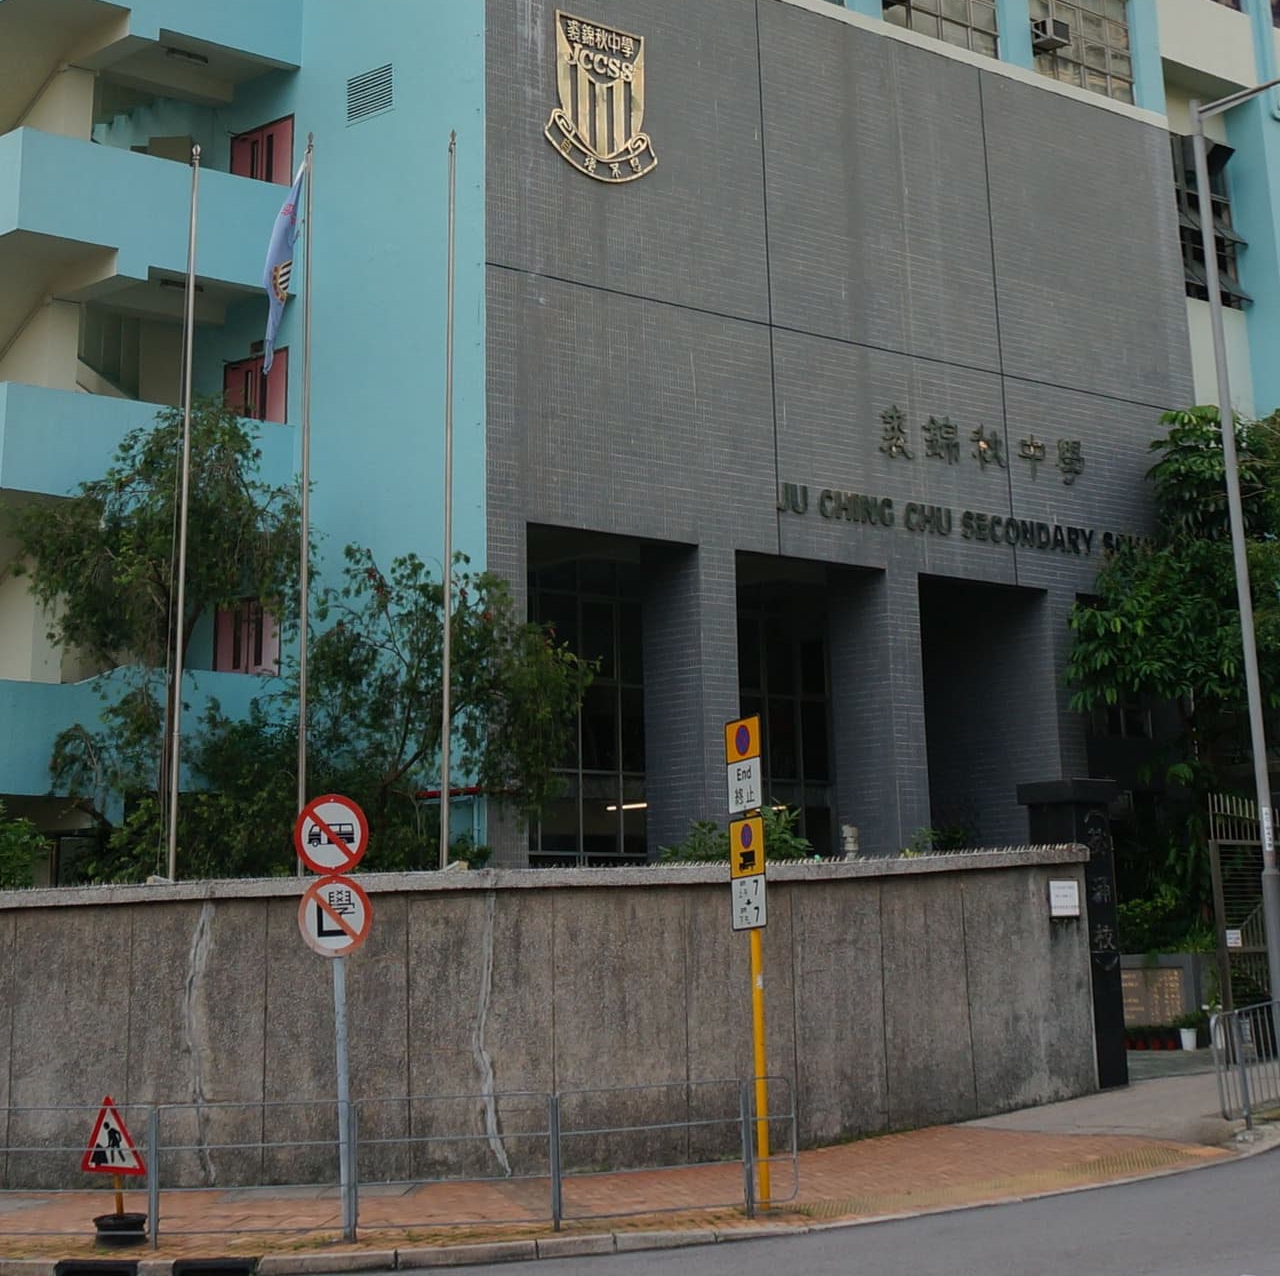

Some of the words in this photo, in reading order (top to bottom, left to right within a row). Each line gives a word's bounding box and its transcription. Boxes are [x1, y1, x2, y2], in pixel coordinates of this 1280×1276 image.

[564, 42, 634, 83] JCCSS
[776, 482, 809, 515] JU
[819, 488, 895, 528] CHING
[904, 501, 952, 537] CHU
[959, 510, 1094, 556] SECONDARY
[736, 765, 752, 782] End
[752, 879, 759, 896] 7
[753, 906, 760, 923] 7
